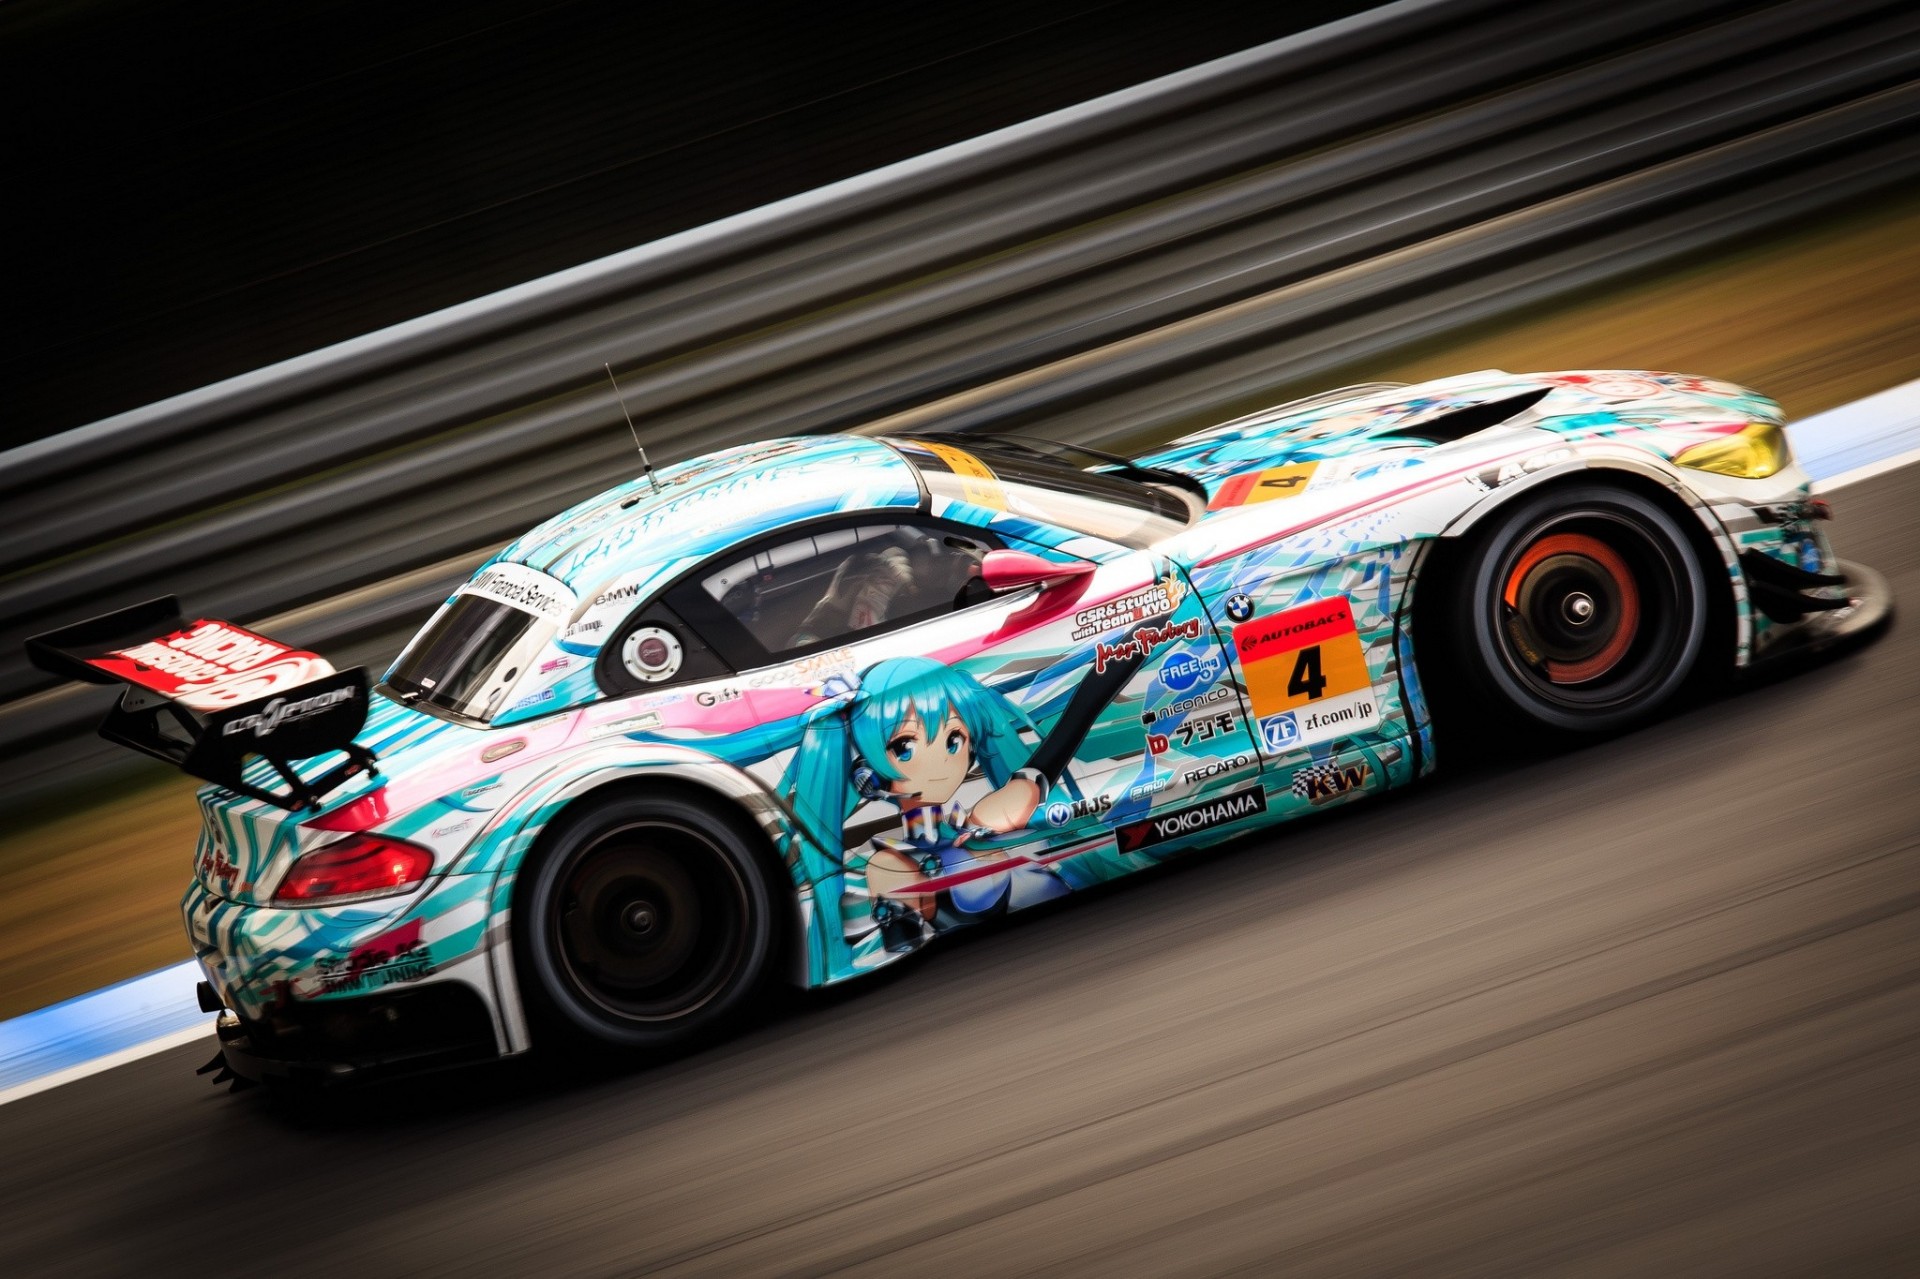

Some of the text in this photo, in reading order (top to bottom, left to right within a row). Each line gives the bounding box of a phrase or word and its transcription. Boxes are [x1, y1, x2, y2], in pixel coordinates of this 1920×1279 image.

[488, 573, 532, 602] Financial
[519, 584, 568, 618] Services
[595, 583, 639, 605] BMW
[1134, 618, 1200, 655] Factory
[1260, 610, 1346, 644] AUTOBACS
[168, 622, 286, 672] RACING
[794, 647, 854, 674] SMILE
[1287, 644, 1327, 700] 4
[1159, 687, 1229, 719] niconico
[1304, 701, 1373, 731] zf.com/jp
[1175, 711, 1235, 746] ブシモ
[1184, 755, 1248, 784] RECARO
[1307, 763, 1369, 800] KW
[1071, 794, 1112, 818] MJS
[1154, 794, 1259, 837] YOKOHAMA
